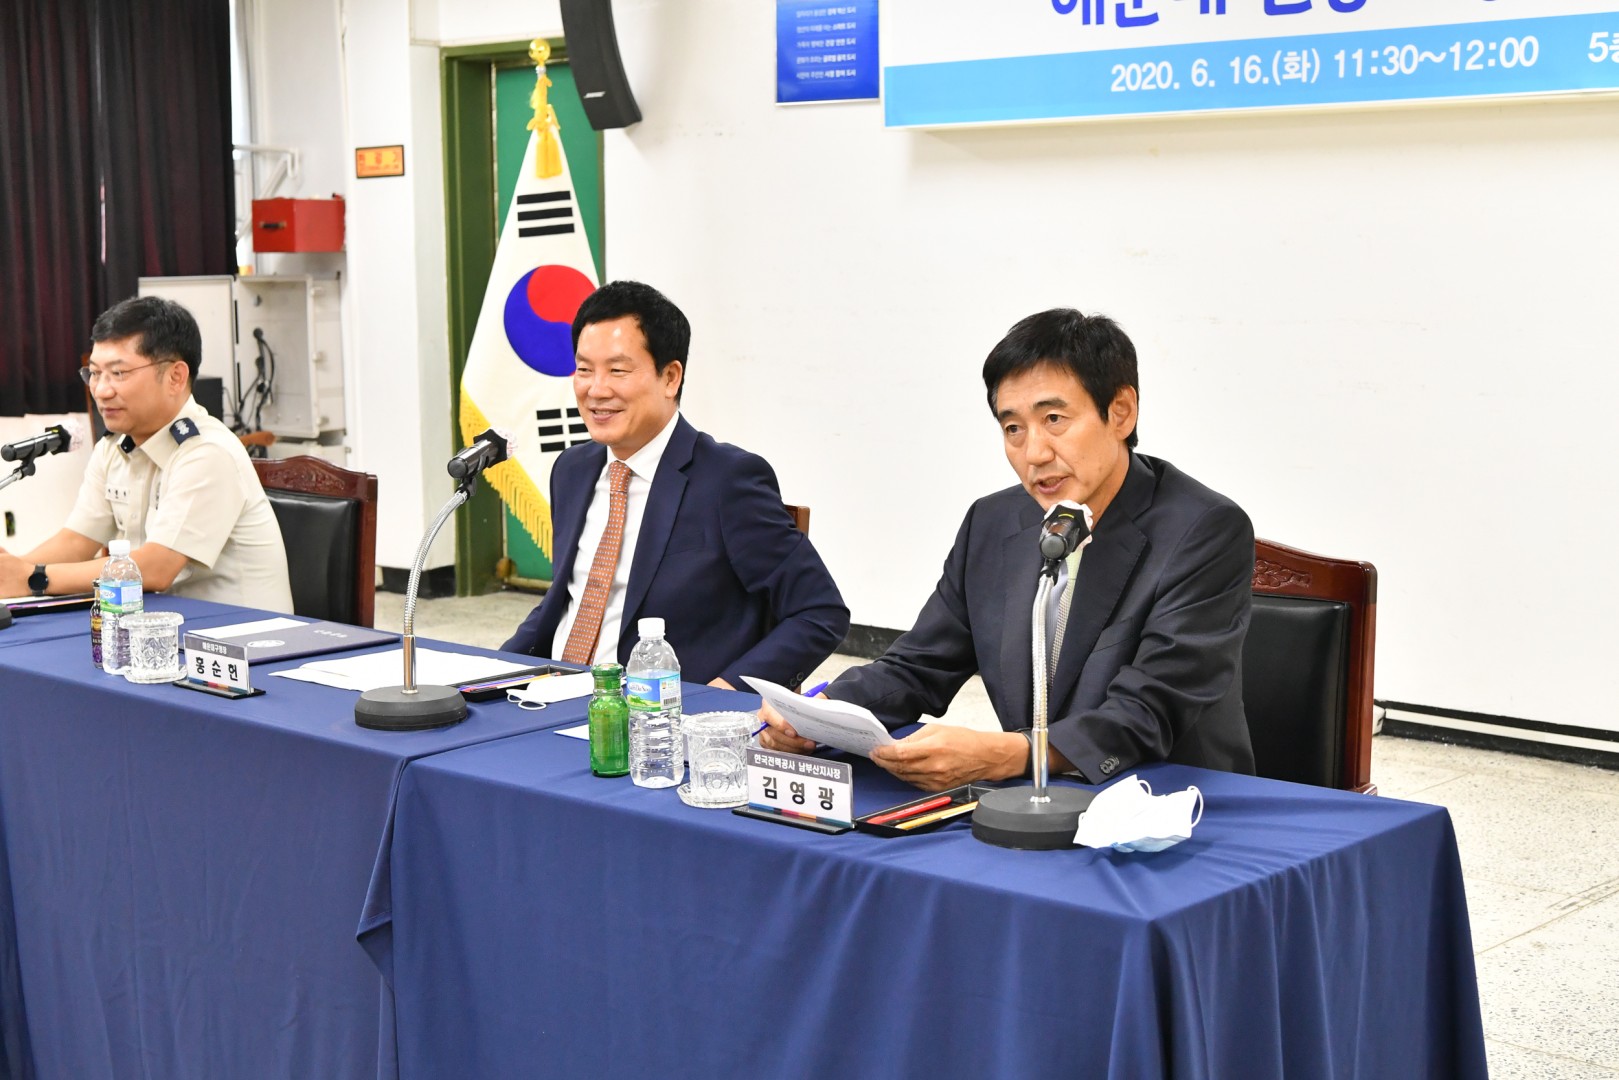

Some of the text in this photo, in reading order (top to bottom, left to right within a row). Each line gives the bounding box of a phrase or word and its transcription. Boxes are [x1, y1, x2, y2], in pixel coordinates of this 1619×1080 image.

[1110, 61, 1180, 92] 2020.
[1190, 58, 1216, 88] 6.
[1228, 48, 1321, 86] 16.(화)
[754, 753, 841, 779] 한국전력공사 남부산지사장
